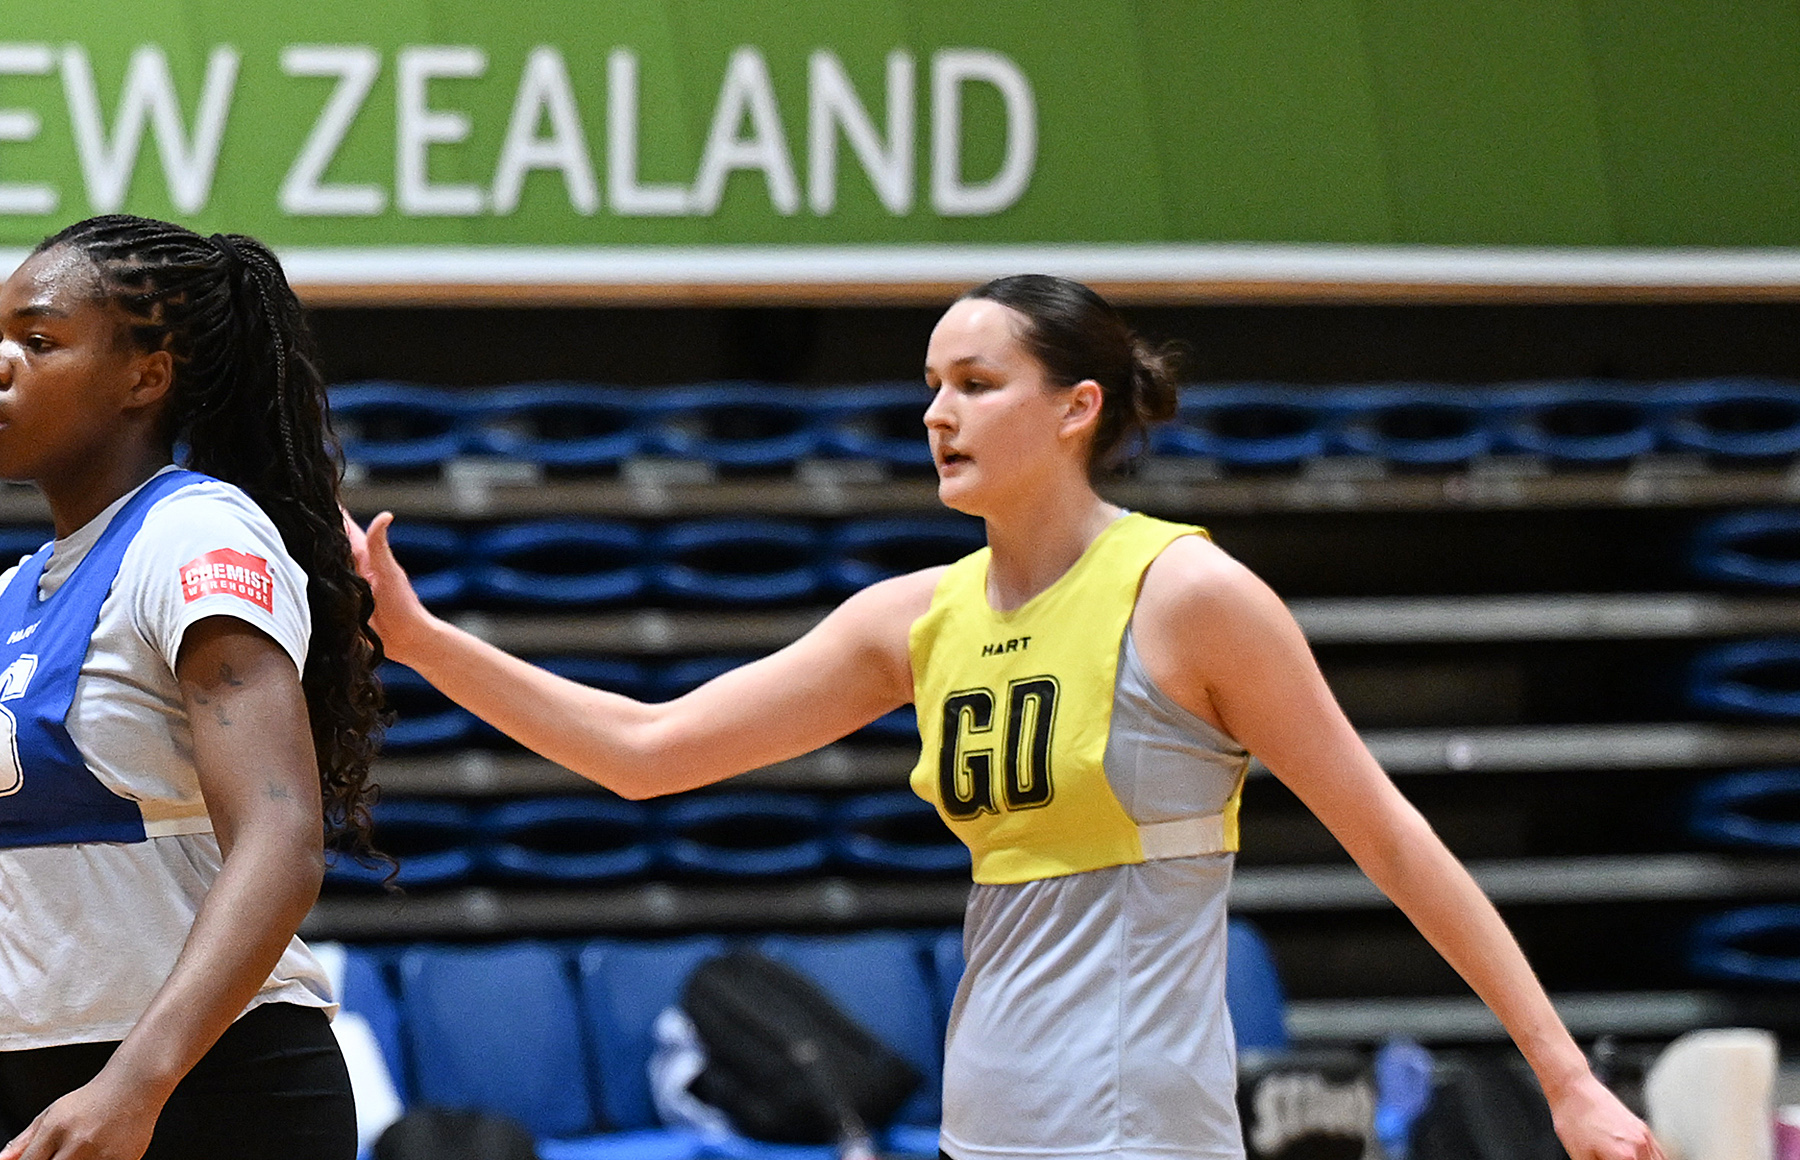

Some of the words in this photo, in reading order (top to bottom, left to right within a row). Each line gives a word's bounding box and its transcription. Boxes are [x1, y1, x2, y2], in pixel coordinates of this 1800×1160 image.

[277, 44, 1038, 216] ZEALAND
[185, 563, 270, 594] CHEMIST
[187, 580, 269, 605] WAREHOUSE
[981, 637, 1031, 657] HART
[938, 674, 1060, 821] GD
